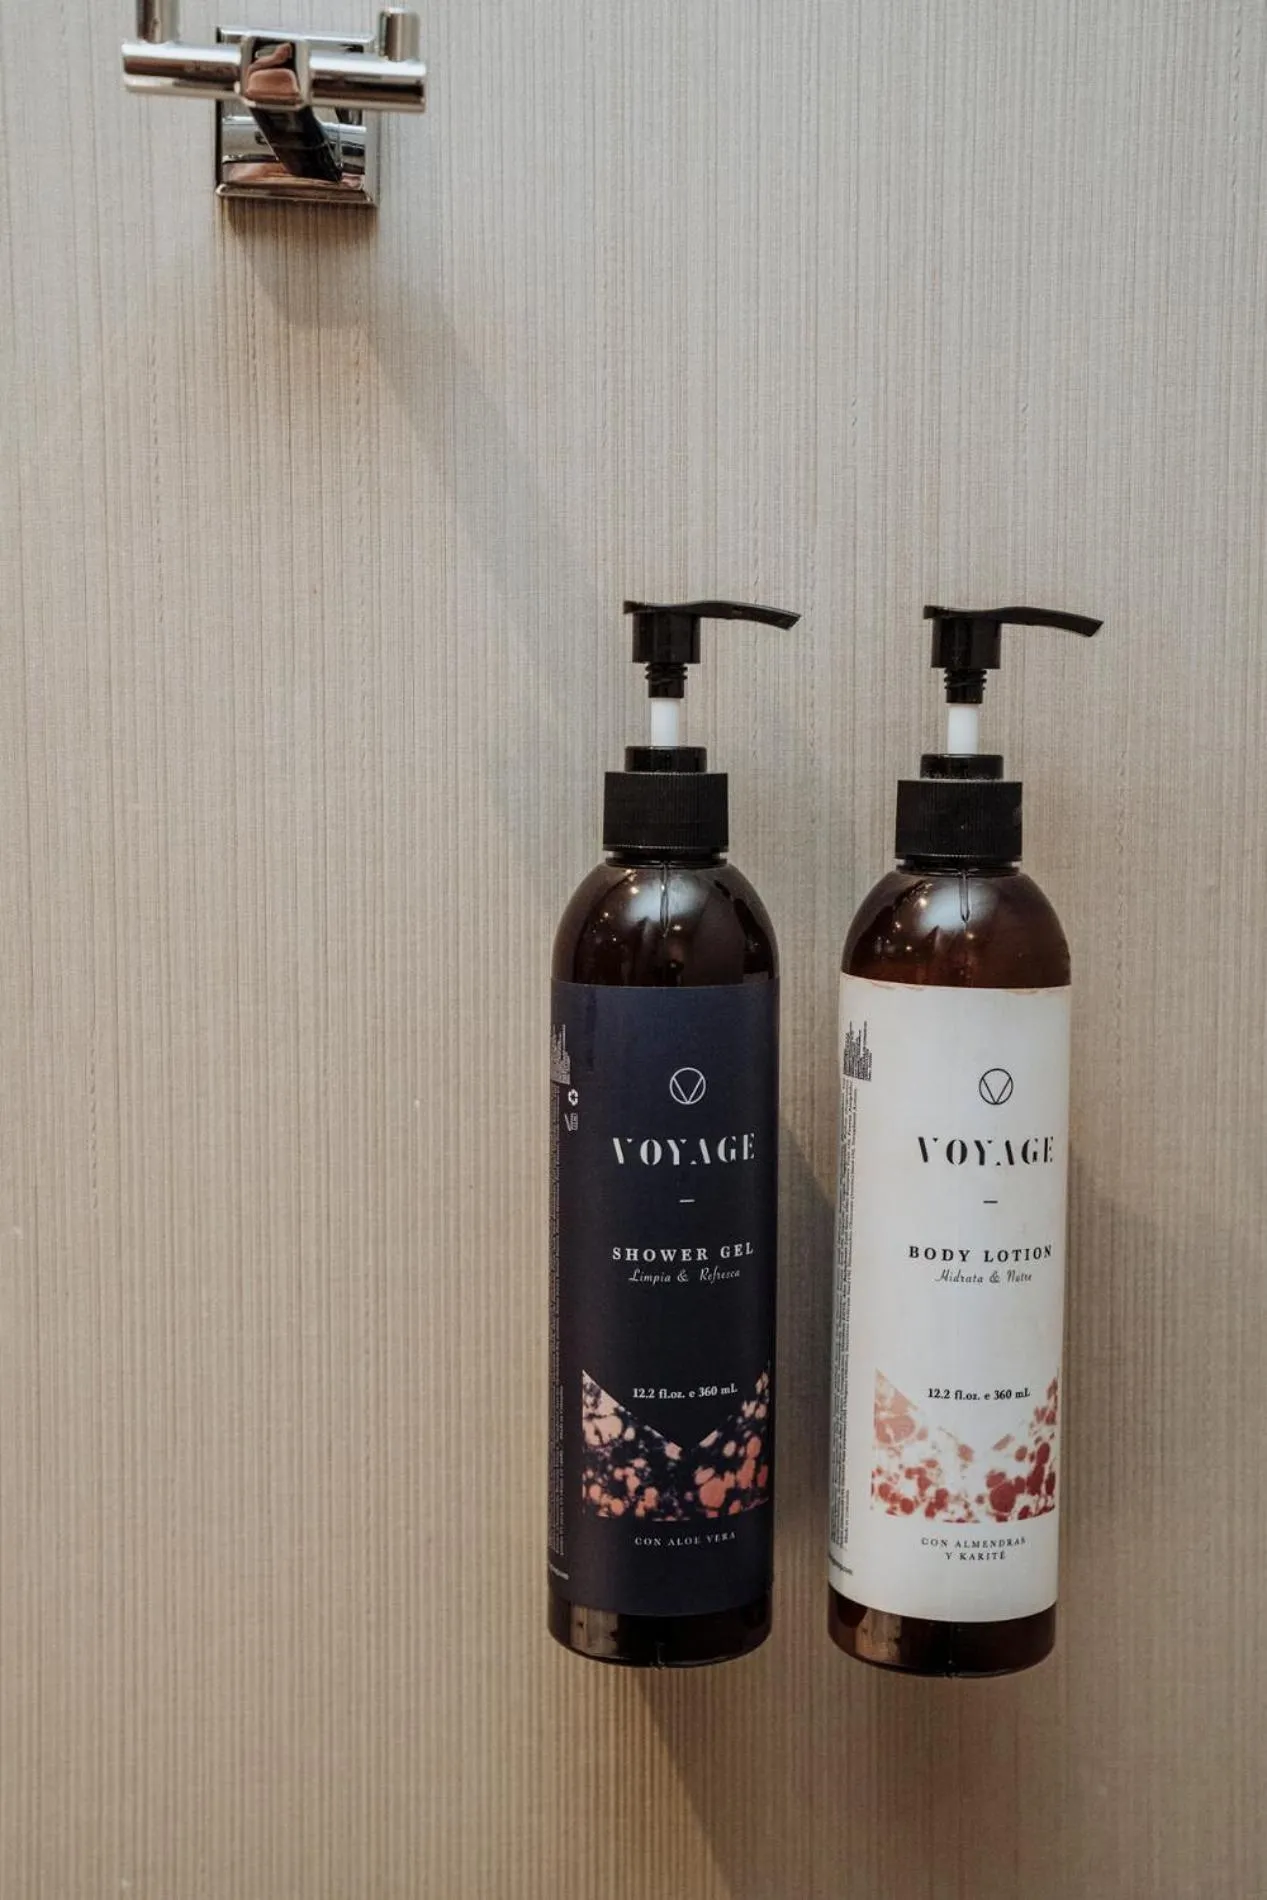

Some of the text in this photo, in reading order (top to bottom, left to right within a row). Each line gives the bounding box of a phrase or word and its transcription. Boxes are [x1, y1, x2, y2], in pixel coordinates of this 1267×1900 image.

[612, 1132, 755, 1166] VOYAGE
[918, 1136, 1053, 1166] VOYAGE
[612, 1241, 754, 1262] SHOWER GEL
[909, 1244, 1052, 1263] BODY LOTION
[628, 1264, 741, 1286] Limpia & Refresca
[934, 1268, 984, 1284] Hidrata
[989, 1270, 1001, 1284] &
[632, 1387, 655, 1399] 12.2
[698, 1385, 718, 1398] 360
[720, 1382, 738, 1395] mL
[928, 1387, 951, 1400] 12.2
[994, 1388, 1013, 1401] 360
[1015, 1386, 1031, 1399] mL
[634, 1530, 736, 1547] CON ALOE VERA
[921, 1536, 1027, 1549] CON ALMENDRAS
